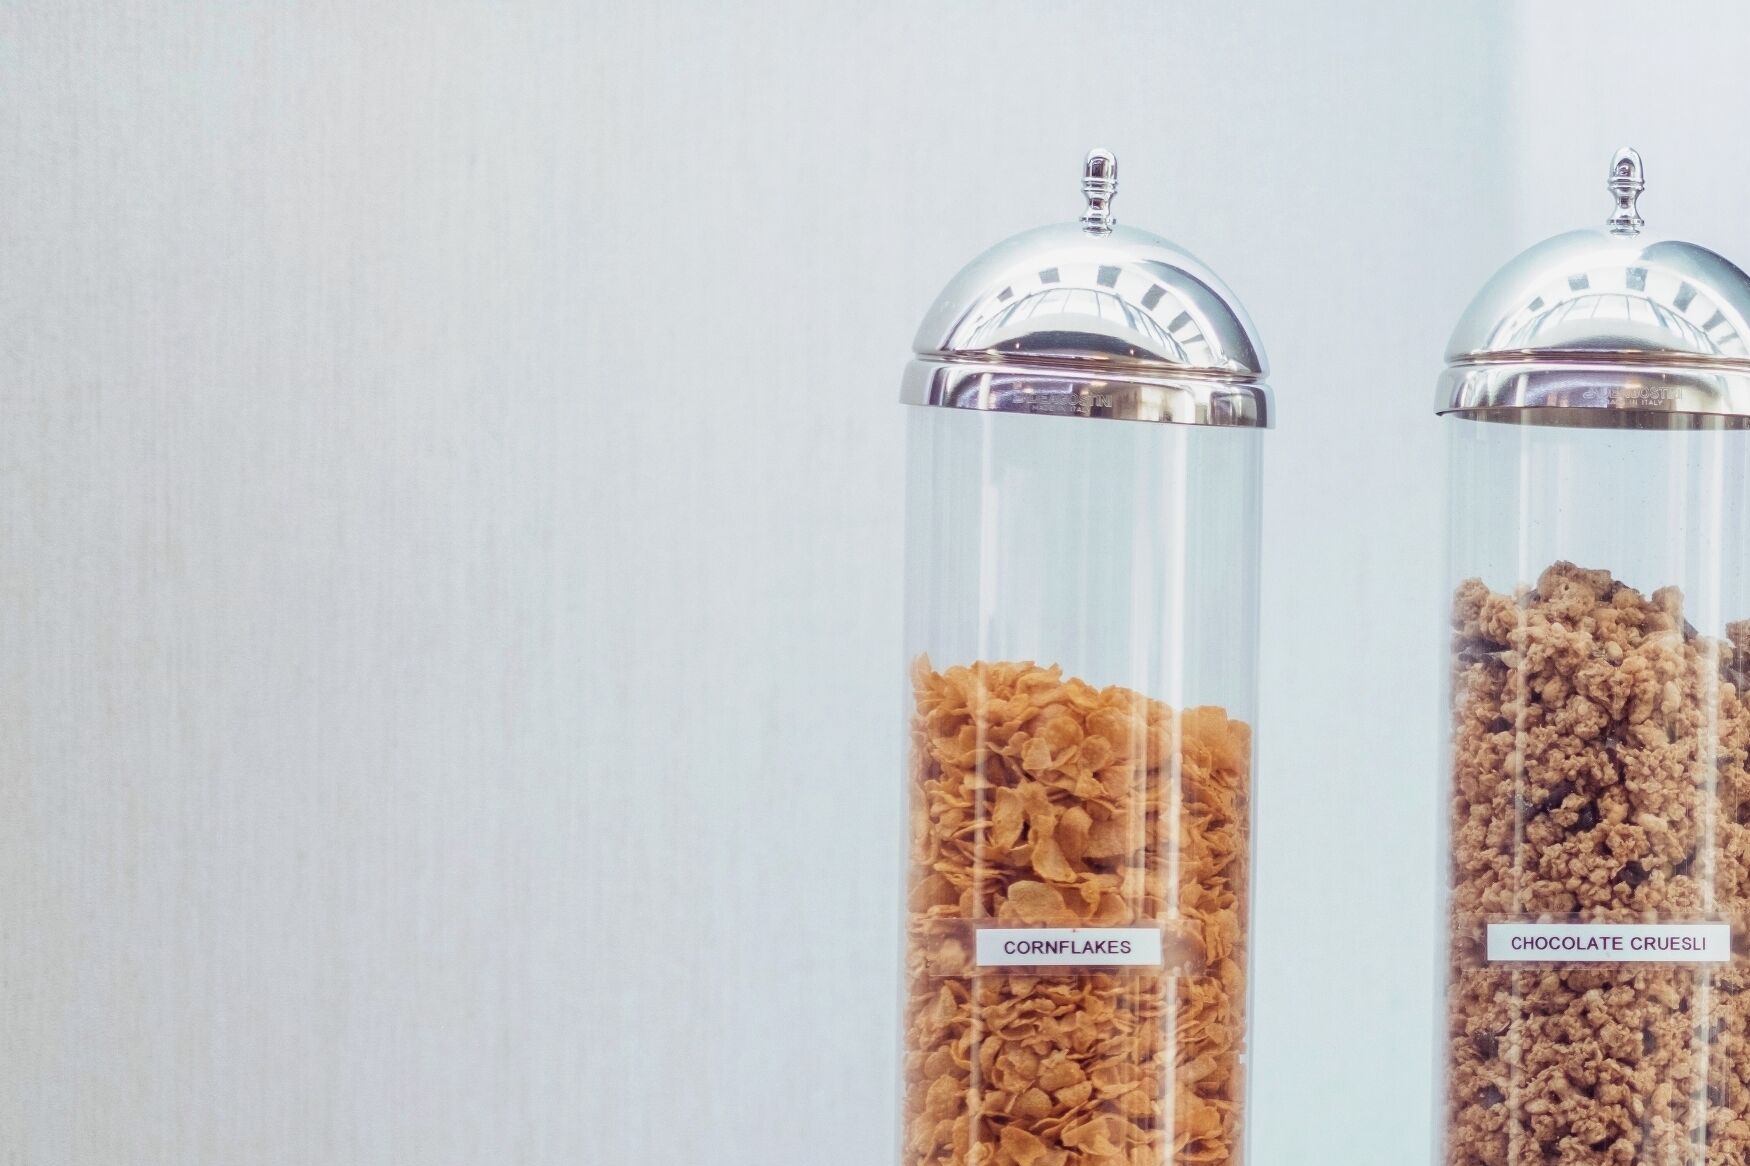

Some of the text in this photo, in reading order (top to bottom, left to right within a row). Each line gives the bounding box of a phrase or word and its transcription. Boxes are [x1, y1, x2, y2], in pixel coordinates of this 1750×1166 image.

[1003, 938, 1133, 956] CORNFLAKES
[1511, 935, 1708, 952] CHOCOLATE CRUESLI
